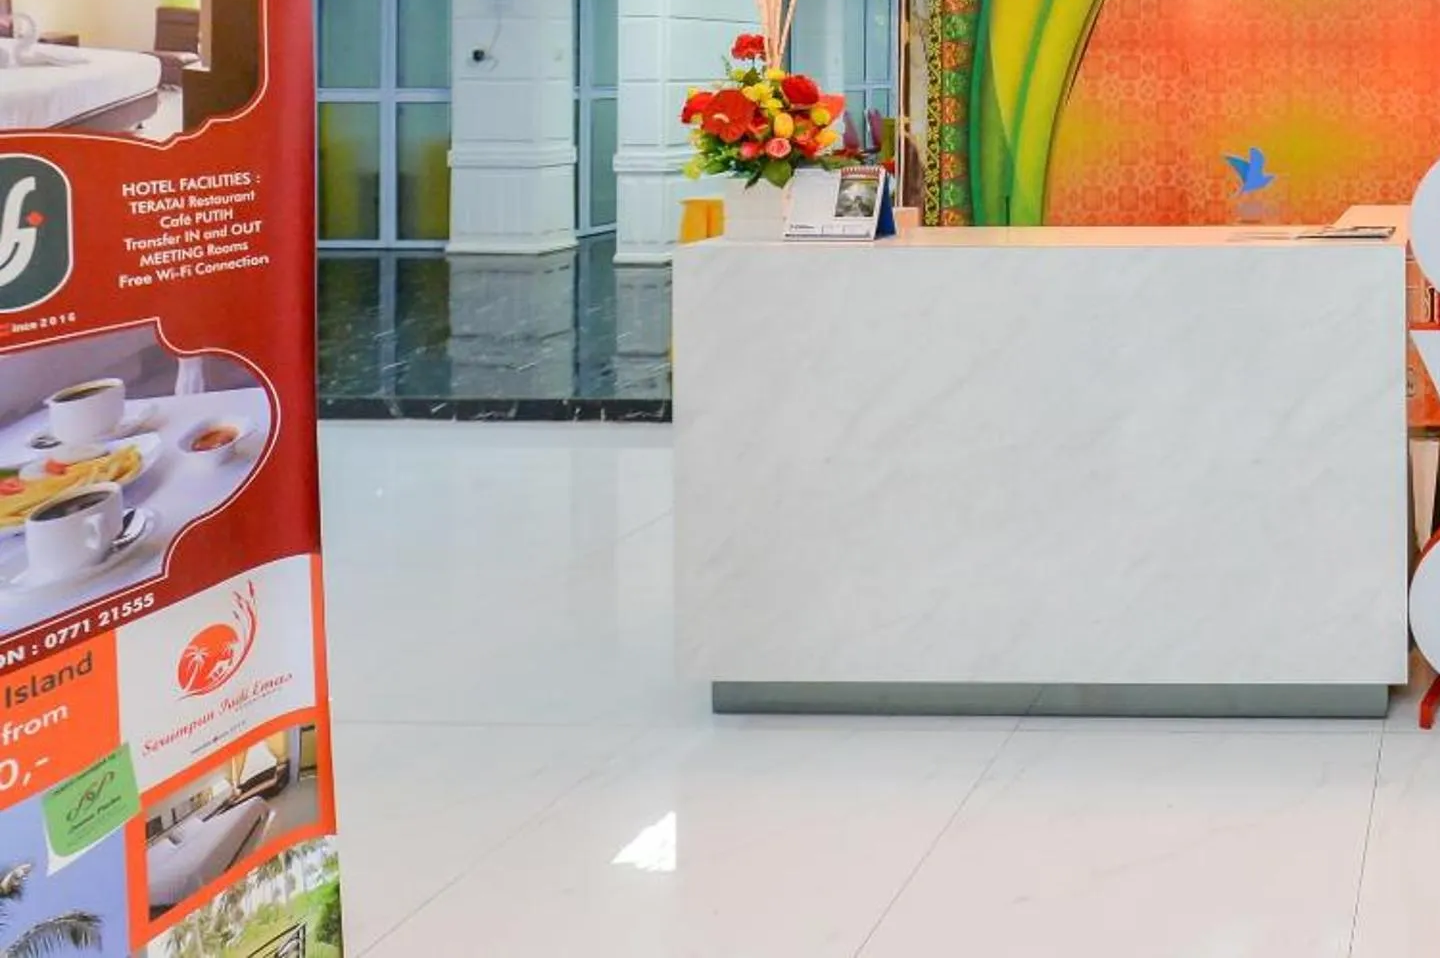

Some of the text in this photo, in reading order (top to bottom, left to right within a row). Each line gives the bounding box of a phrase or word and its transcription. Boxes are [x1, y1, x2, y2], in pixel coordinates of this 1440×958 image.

[122, 180, 175, 197] HOTEL
[180, 172, 251, 191] FACILITIES
[130, 190, 255, 214] TERATAI Restaurant
[195, 209, 233, 224] PUTIH
[124, 221, 262, 250] Transfer IN and OUT
[140, 241, 248, 267] MEETING Rooms
[119, 256, 269, 288] Free Wi-Fi Connection
[45, 620, 91, 649] 0771
[98, 593, 154, 626] 21555
[5, 650, 93, 708] Island
[2, 705, 69, 745] from
